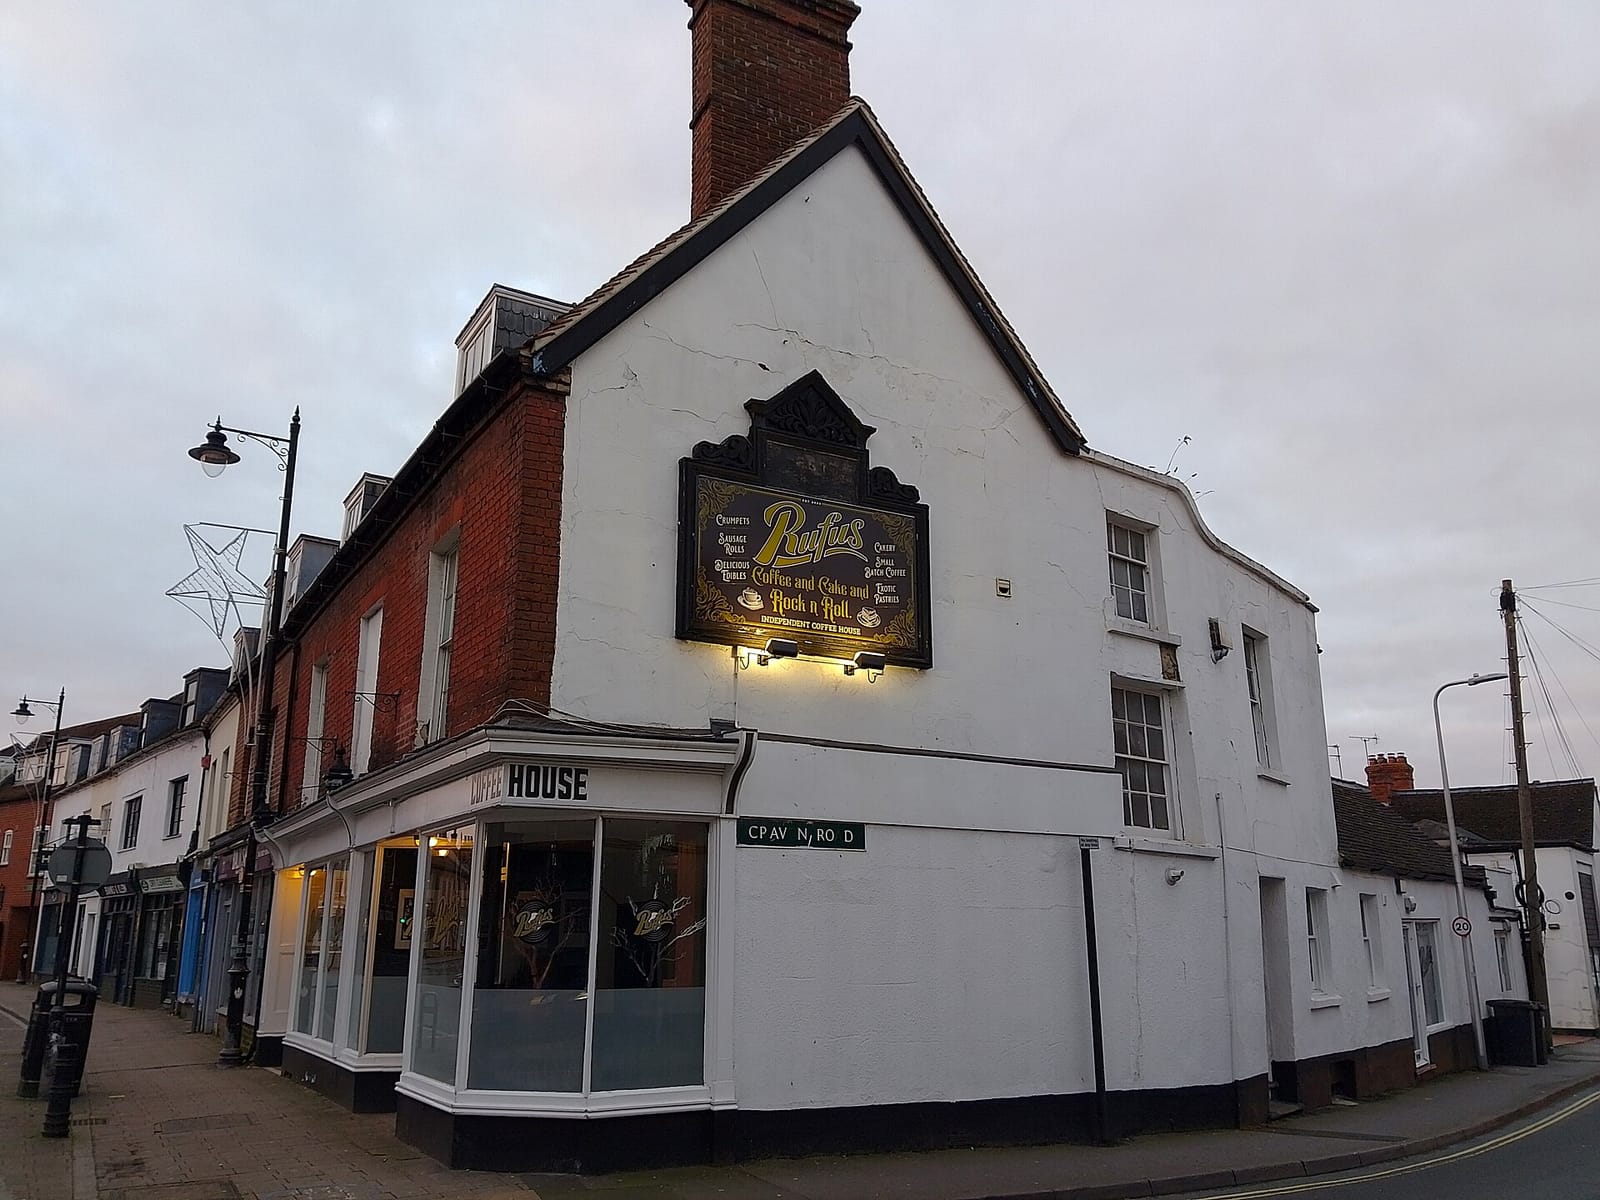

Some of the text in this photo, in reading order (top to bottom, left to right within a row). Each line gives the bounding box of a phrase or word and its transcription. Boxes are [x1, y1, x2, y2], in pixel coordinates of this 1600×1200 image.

[715, 513, 750, 526] CRUMPETS
[718, 532, 747, 545] SAUSAGE
[753, 500, 868, 568] Rufus
[723, 543, 745, 556] ROLLS
[714, 559, 750, 571] DELICIOUS
[875, 556, 895, 568] SMALL
[720, 569, 747, 582] EDIBLES
[864, 566, 906, 579] BATCH COFFEE
[751, 566, 869, 600] Coffee and Cake and
[875, 582, 896, 595] EXOTIC
[769, 588, 806, 617] Rock
[810, 600, 819, 616] n
[873, 593, 900, 605] PASTRIES
[761, 615, 861, 636] INDEPENDENT COFFEE HOUSE
[507, 764, 589, 800] HOUSE
[1455, 922, 1469, 931] 20
